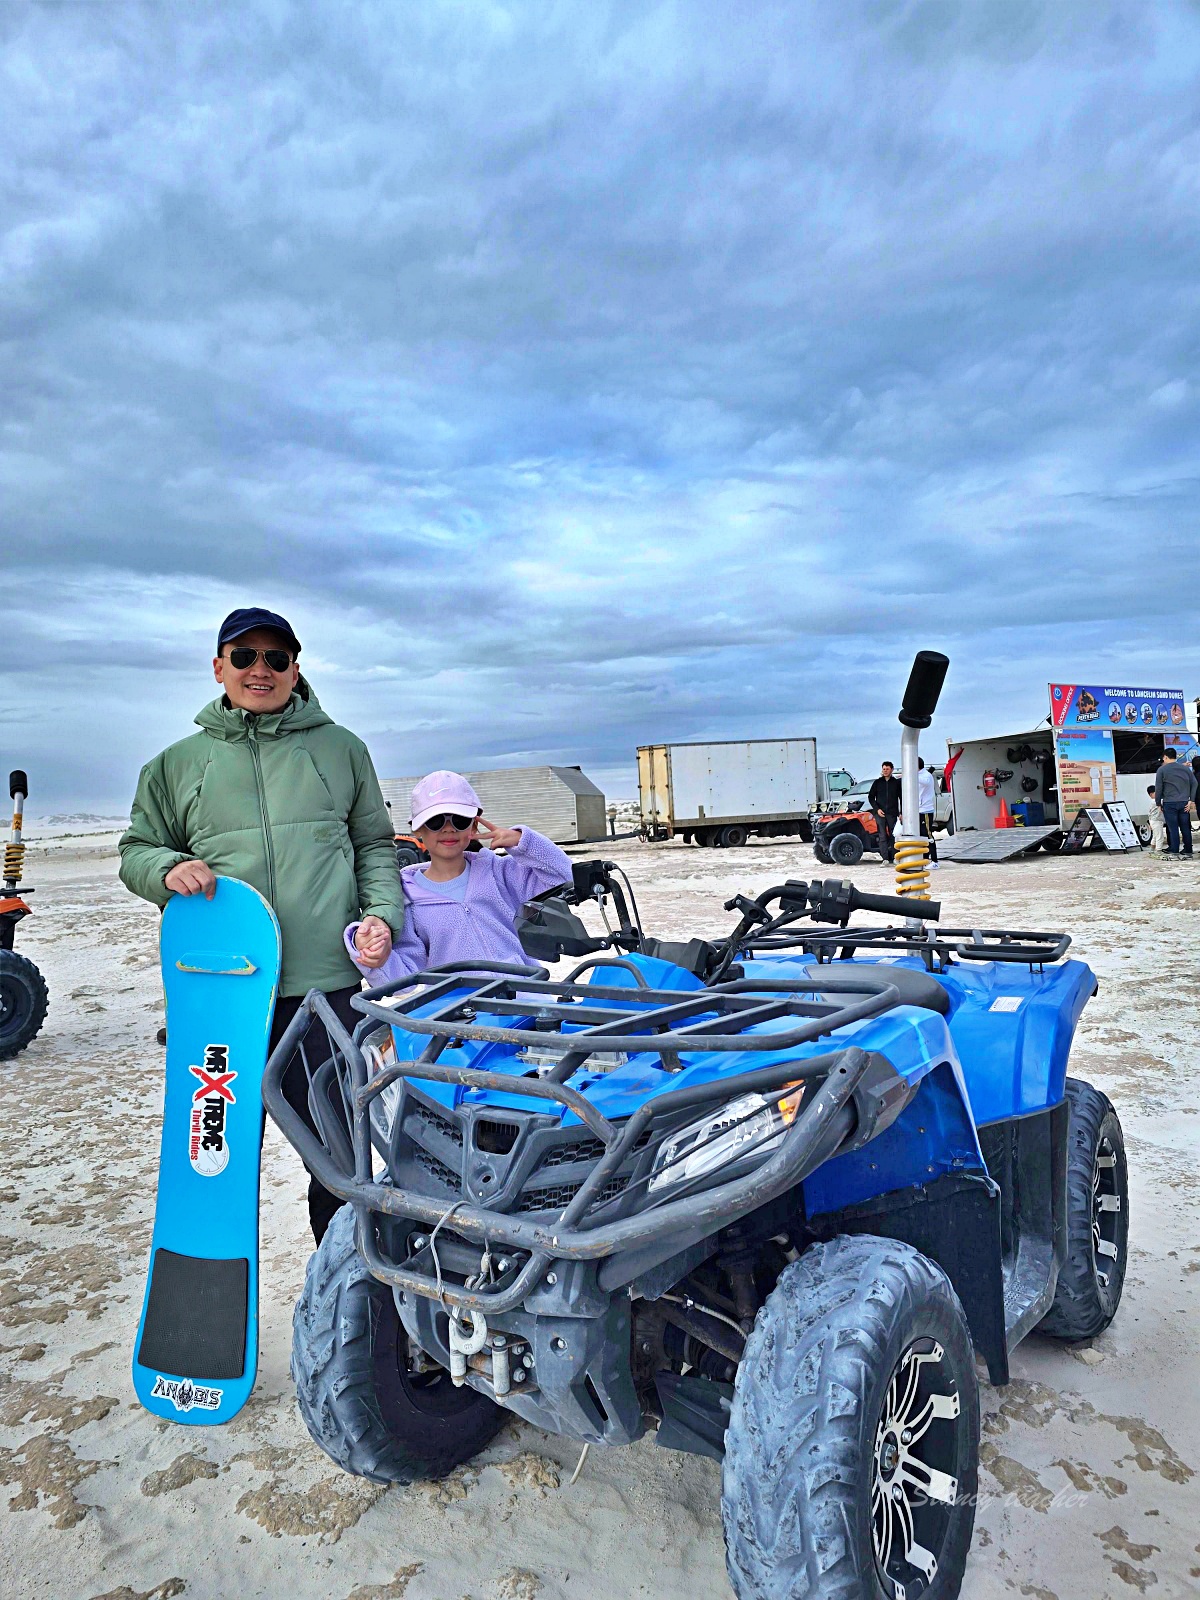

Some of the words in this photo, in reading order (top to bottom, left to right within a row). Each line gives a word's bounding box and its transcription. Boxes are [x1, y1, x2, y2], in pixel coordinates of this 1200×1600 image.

[1104, 688, 1127, 697] WELCOME
[1127, 689, 1134, 698] TO
[1134, 690, 1156, 698] LANCELIN
[1156, 690, 1168, 699] SAND
[1168, 691, 1183, 700] DUNES
[206, 1046, 228, 1073] MR
[192, 1109, 202, 1134] Thrill
[190, 1135, 201, 1161] Rides
